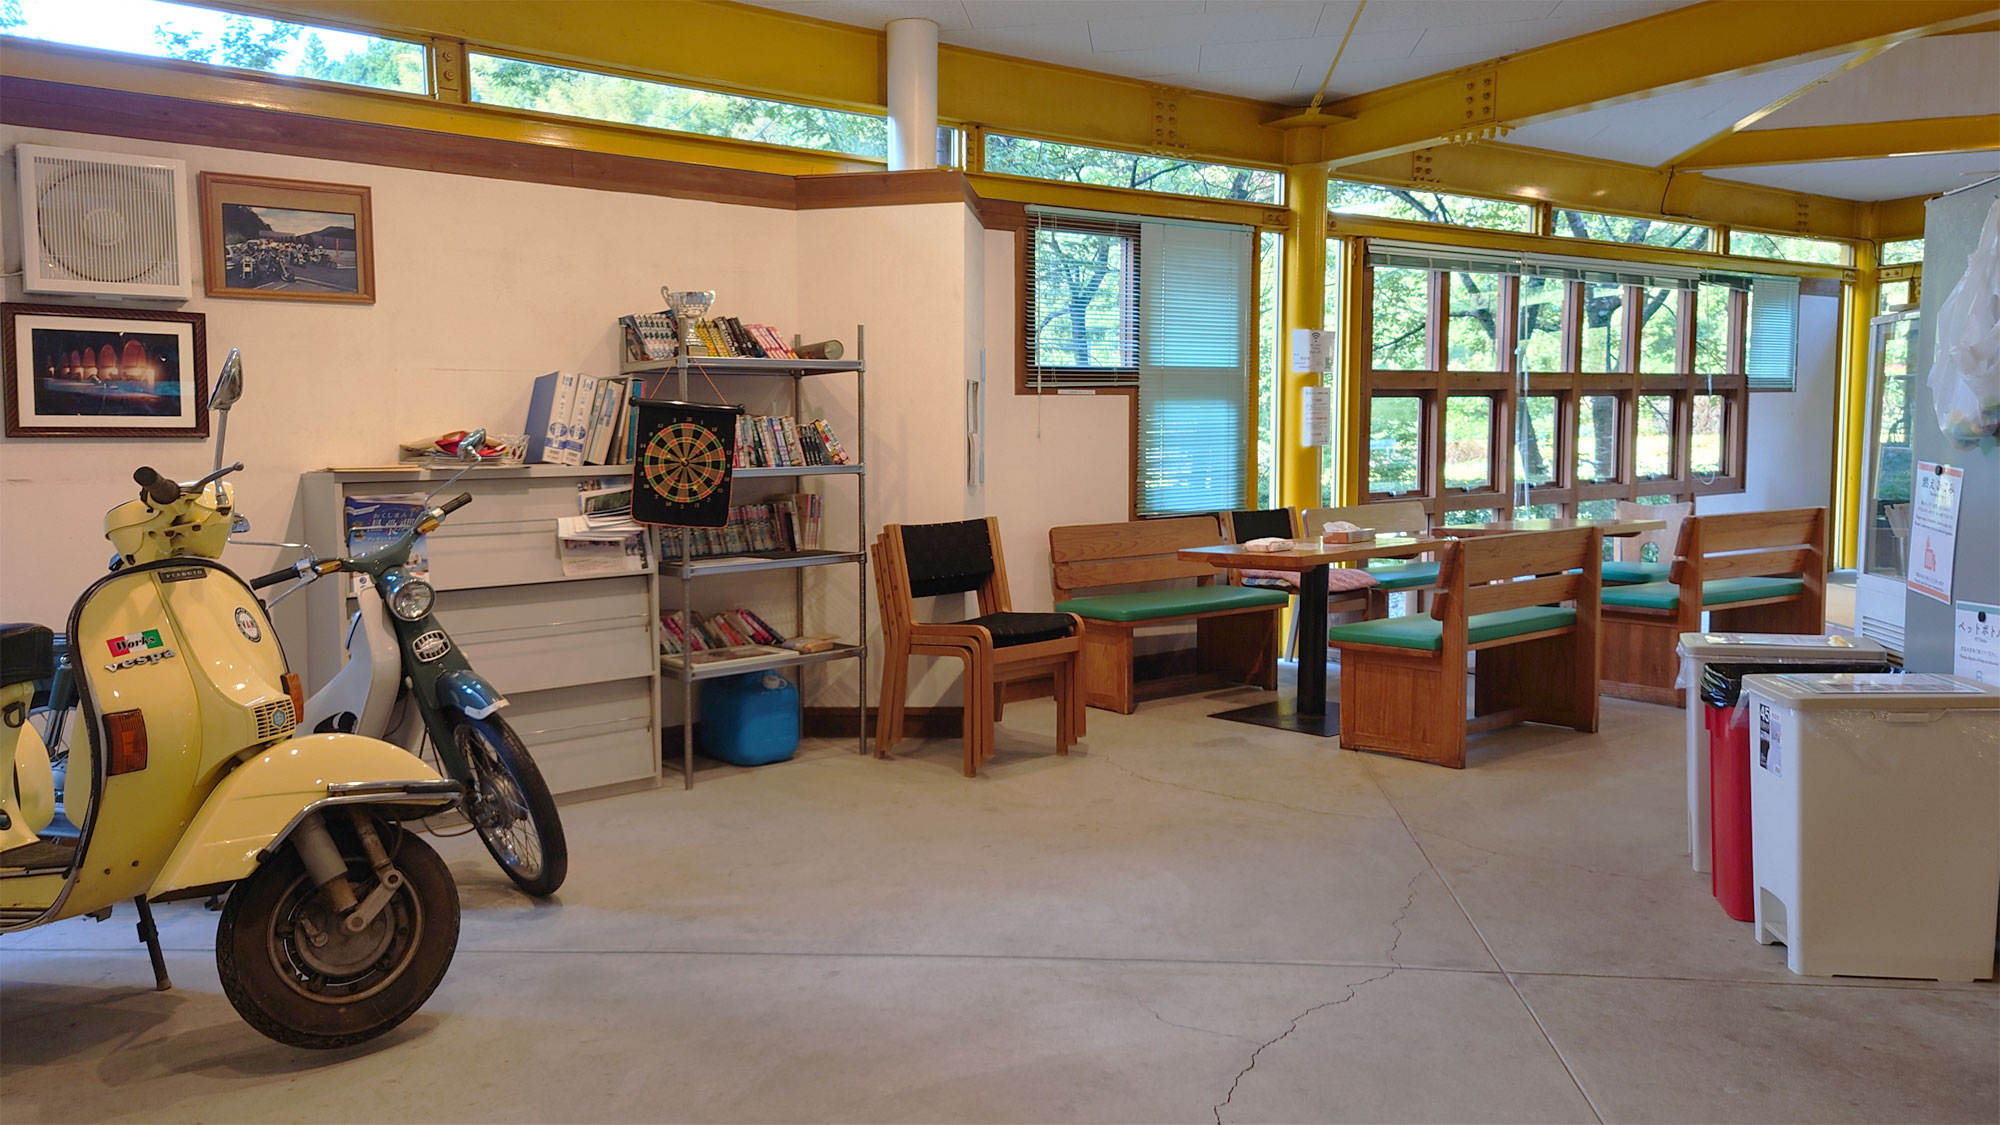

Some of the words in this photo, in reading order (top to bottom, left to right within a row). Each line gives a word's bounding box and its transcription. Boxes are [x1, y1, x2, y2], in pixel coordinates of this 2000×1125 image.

[115, 635, 157, 651] Works
[104, 648, 176, 673] vespa
[1760, 704, 1770, 723] 45
